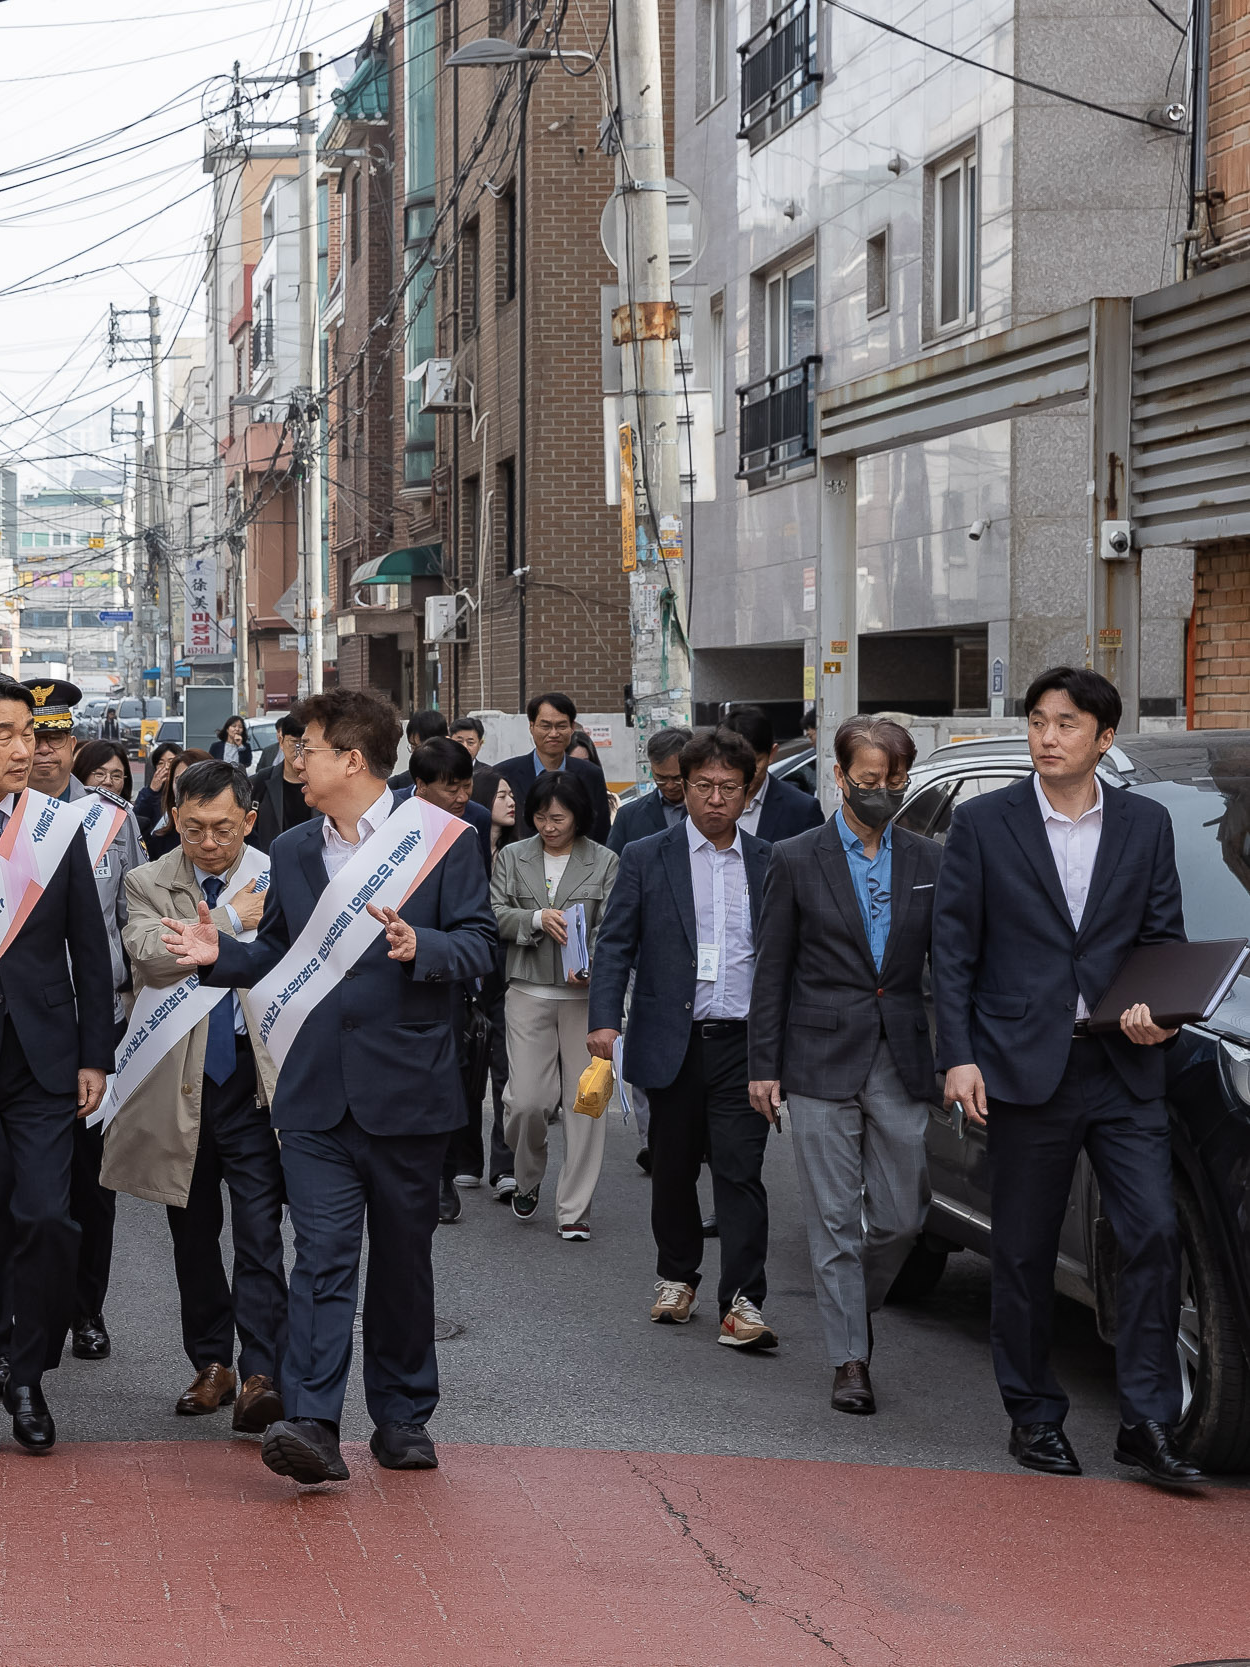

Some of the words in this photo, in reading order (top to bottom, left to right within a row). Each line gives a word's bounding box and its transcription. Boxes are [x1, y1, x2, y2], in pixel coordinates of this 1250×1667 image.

[191, 612, 210, 646] 미용실
[389, 828, 422, 867] 소중한
[347, 862, 393, 914] 아이들의
[317, 909, 355, 962] 등하굣길
[276, 957, 321, 1007] 안전하게
[145, 986, 189, 1032] 안전하게
[260, 1000, 283, 1047] 지켜주세
[116, 1025, 148, 1078] 지켜주세요
